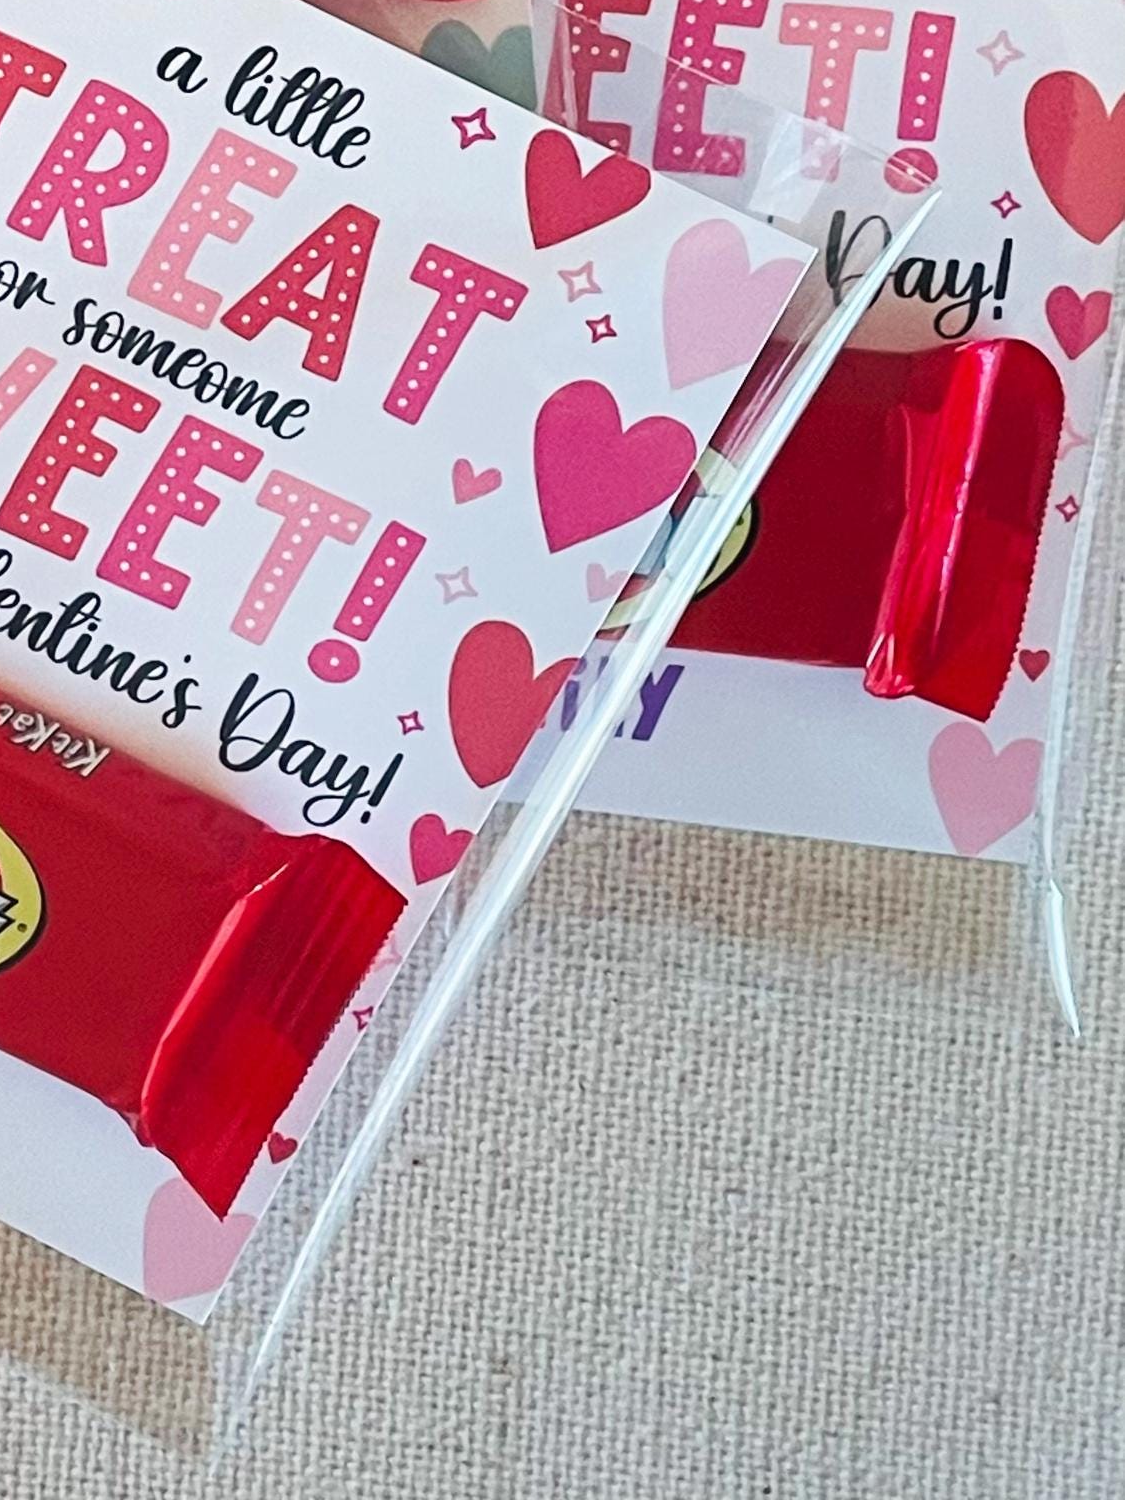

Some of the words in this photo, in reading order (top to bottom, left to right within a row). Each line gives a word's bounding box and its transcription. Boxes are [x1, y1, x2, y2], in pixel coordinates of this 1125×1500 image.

[156, 43, 207, 96] a
[226, 45, 373, 171] little
[219, 672, 404, 826] Day!
